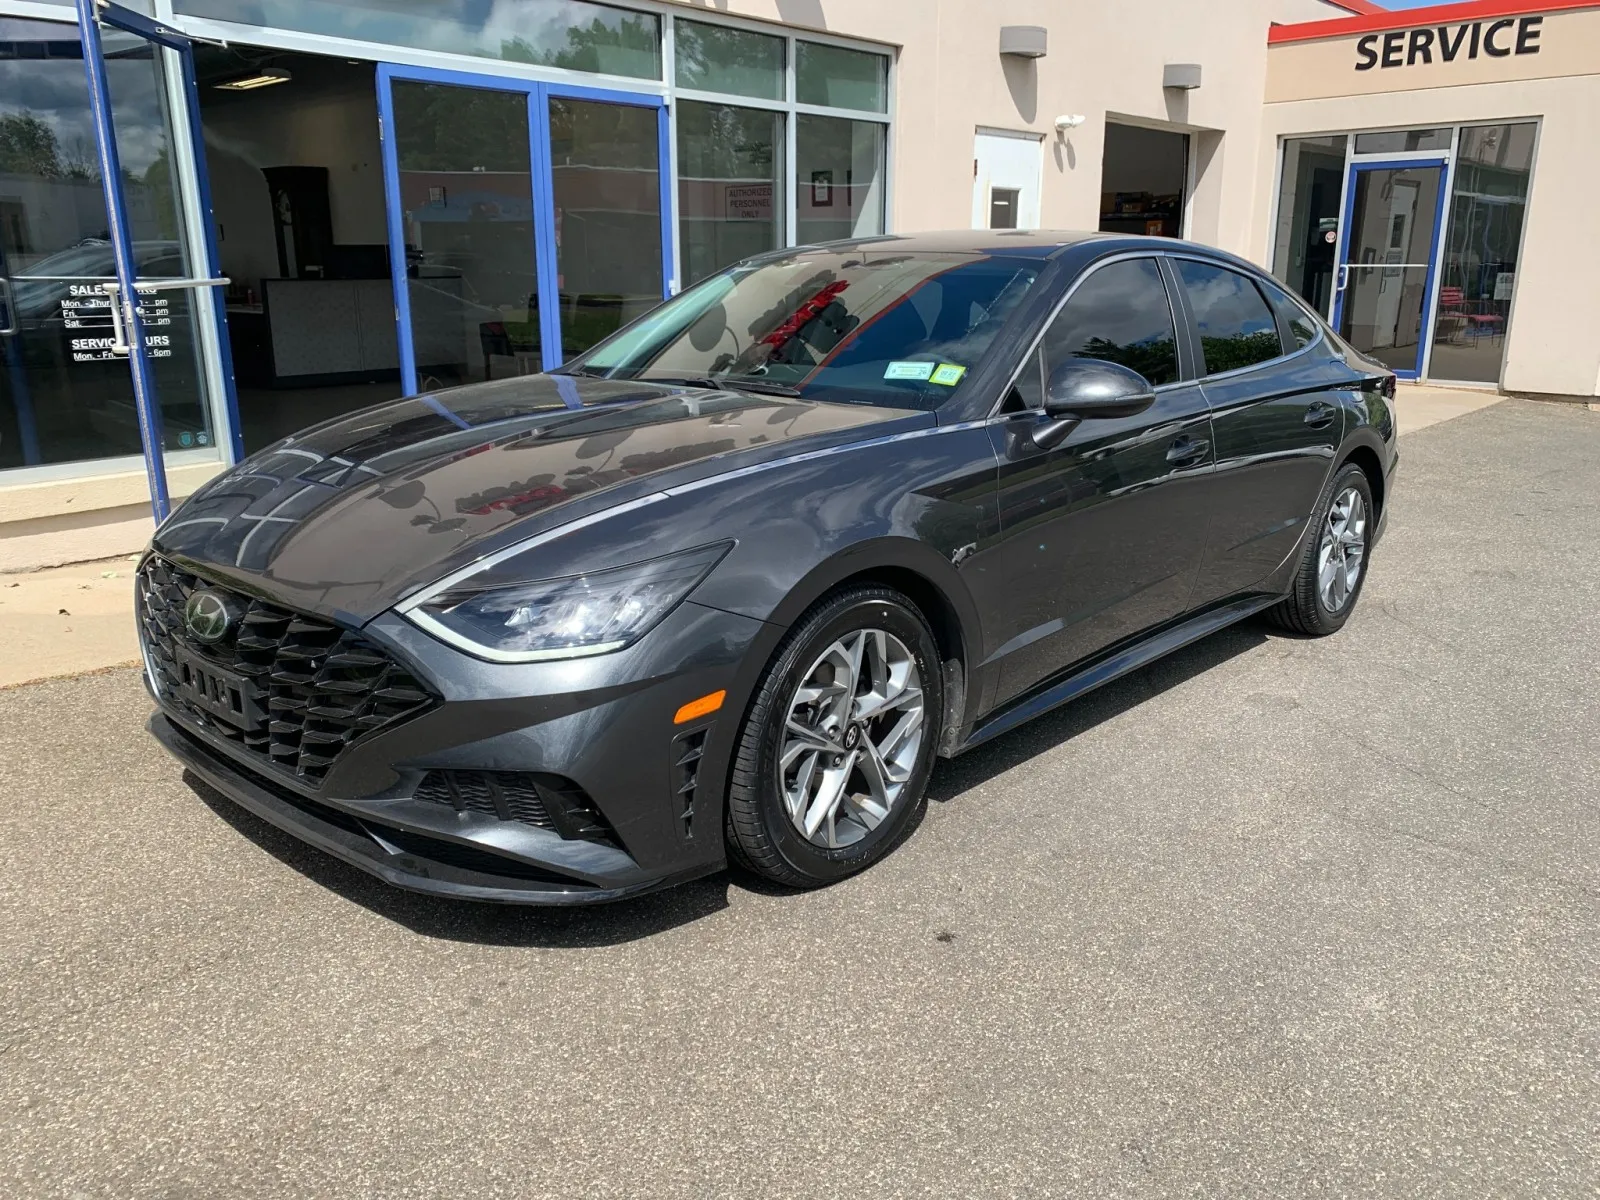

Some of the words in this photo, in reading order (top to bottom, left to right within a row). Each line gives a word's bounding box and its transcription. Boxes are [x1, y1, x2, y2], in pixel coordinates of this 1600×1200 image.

[1355, 16, 1543, 71] SERVICE
[729, 188, 772, 198] AUTHORIZED
[730, 199, 771, 208] PERSONNEL
[741, 211, 759, 219] ONLY
[72, 338, 116, 348] SERVIC
[145, 336, 170, 345] URS
